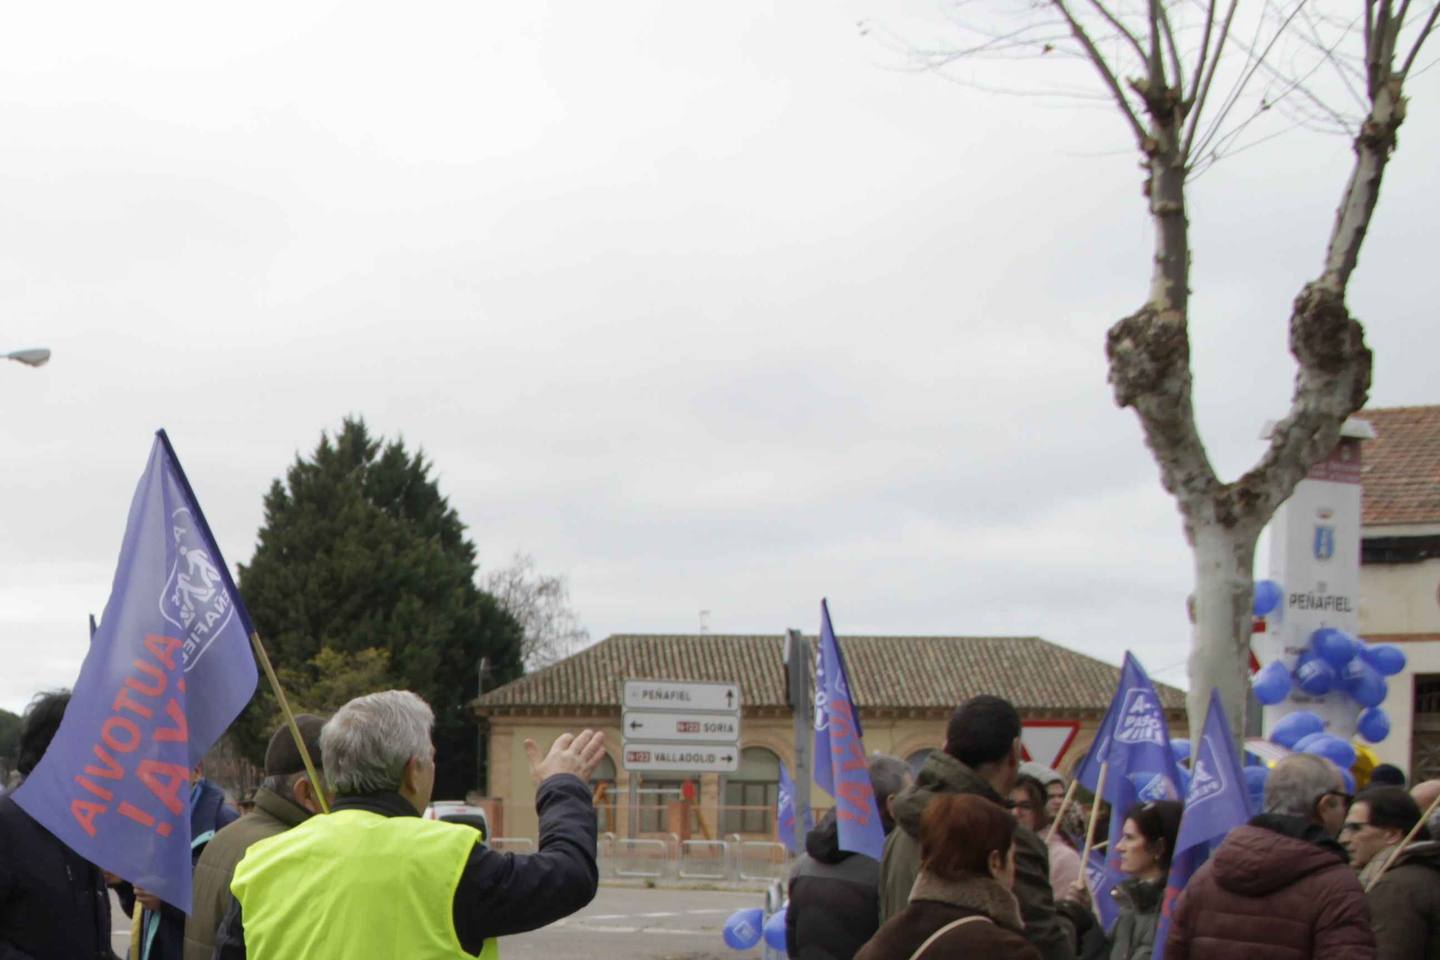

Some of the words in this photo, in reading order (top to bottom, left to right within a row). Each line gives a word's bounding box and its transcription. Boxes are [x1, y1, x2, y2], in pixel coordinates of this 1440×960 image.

[1288, 592, 1352, 613] PEÑAFIEL
[641, 688, 692, 702] PEÑAFIEL
[703, 723, 734, 734] SORIA
[653, 752, 717, 764] VALLADOLID
